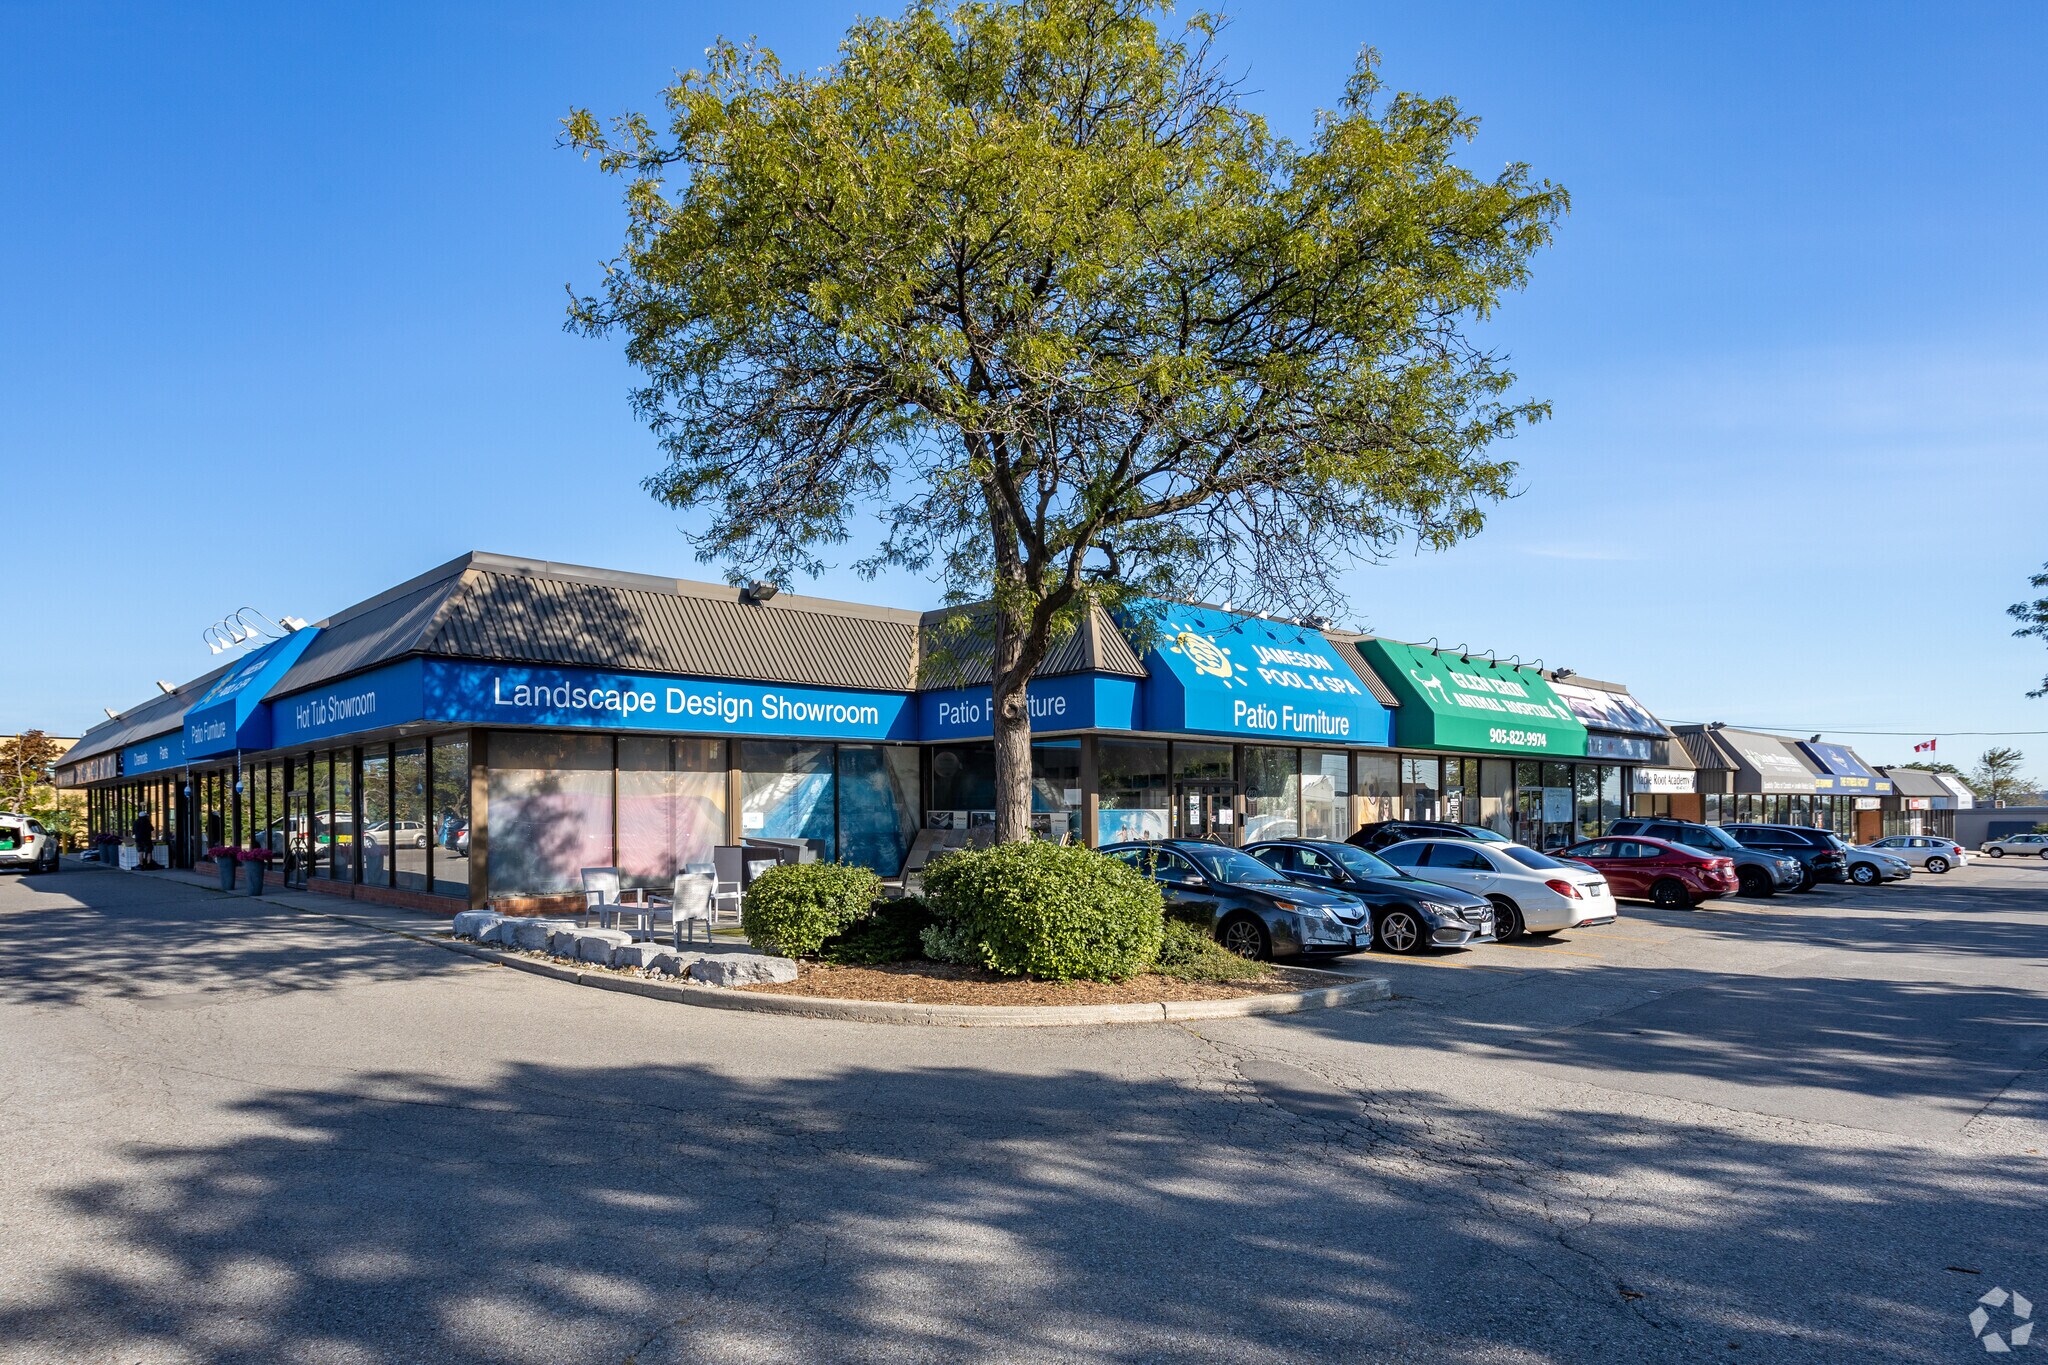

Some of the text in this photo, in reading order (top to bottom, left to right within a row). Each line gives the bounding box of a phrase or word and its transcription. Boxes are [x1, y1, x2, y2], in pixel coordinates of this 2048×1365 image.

[1251, 644, 1334, 672] JAMESON
[1257, 667, 1362, 696] POOL & SPA
[1449, 671, 1530, 699] GLEN ERIN
[296, 691, 376, 730] Hot Tub Showroom
[494, 676, 879, 725] Landscape Design Showroom
[939, 695, 1067, 725] Patio Fiture
[1452, 692, 1558, 719] ANIMAL HOSPITAL
[1234, 699, 1350, 736] Patio Furniture
[191, 720, 226, 744] Patio Furniture
[1489, 728, 1547, 747] 905-822-9974
[1653, 773, 1667, 786] Root
[1668, 773, 1690, 787] Academy
